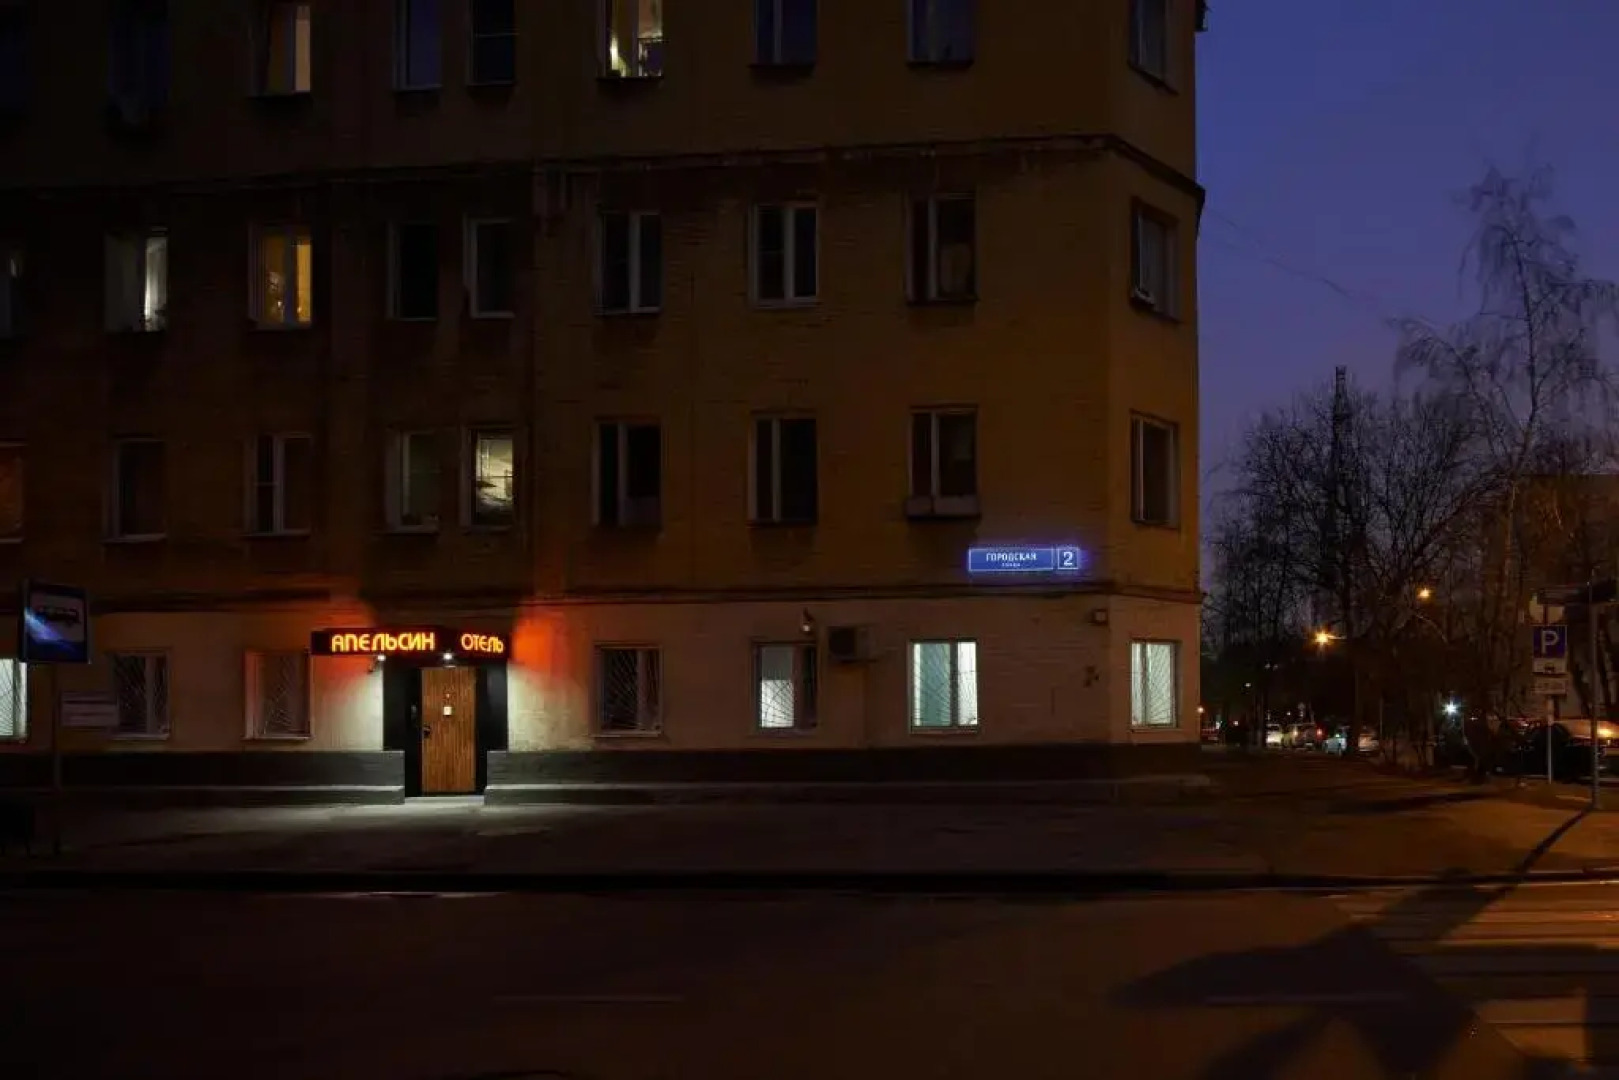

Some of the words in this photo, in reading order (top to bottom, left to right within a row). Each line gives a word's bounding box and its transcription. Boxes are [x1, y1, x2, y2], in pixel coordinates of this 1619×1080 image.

[986, 552, 1037, 562] ГОРОДСКАЯ
[1063, 551, 1073, 566] 2
[331, 632, 435, 652] АПЕЛЬСИН
[461, 633, 504, 653] ОТЕЛЬ
[1541, 630, 1559, 654] P
